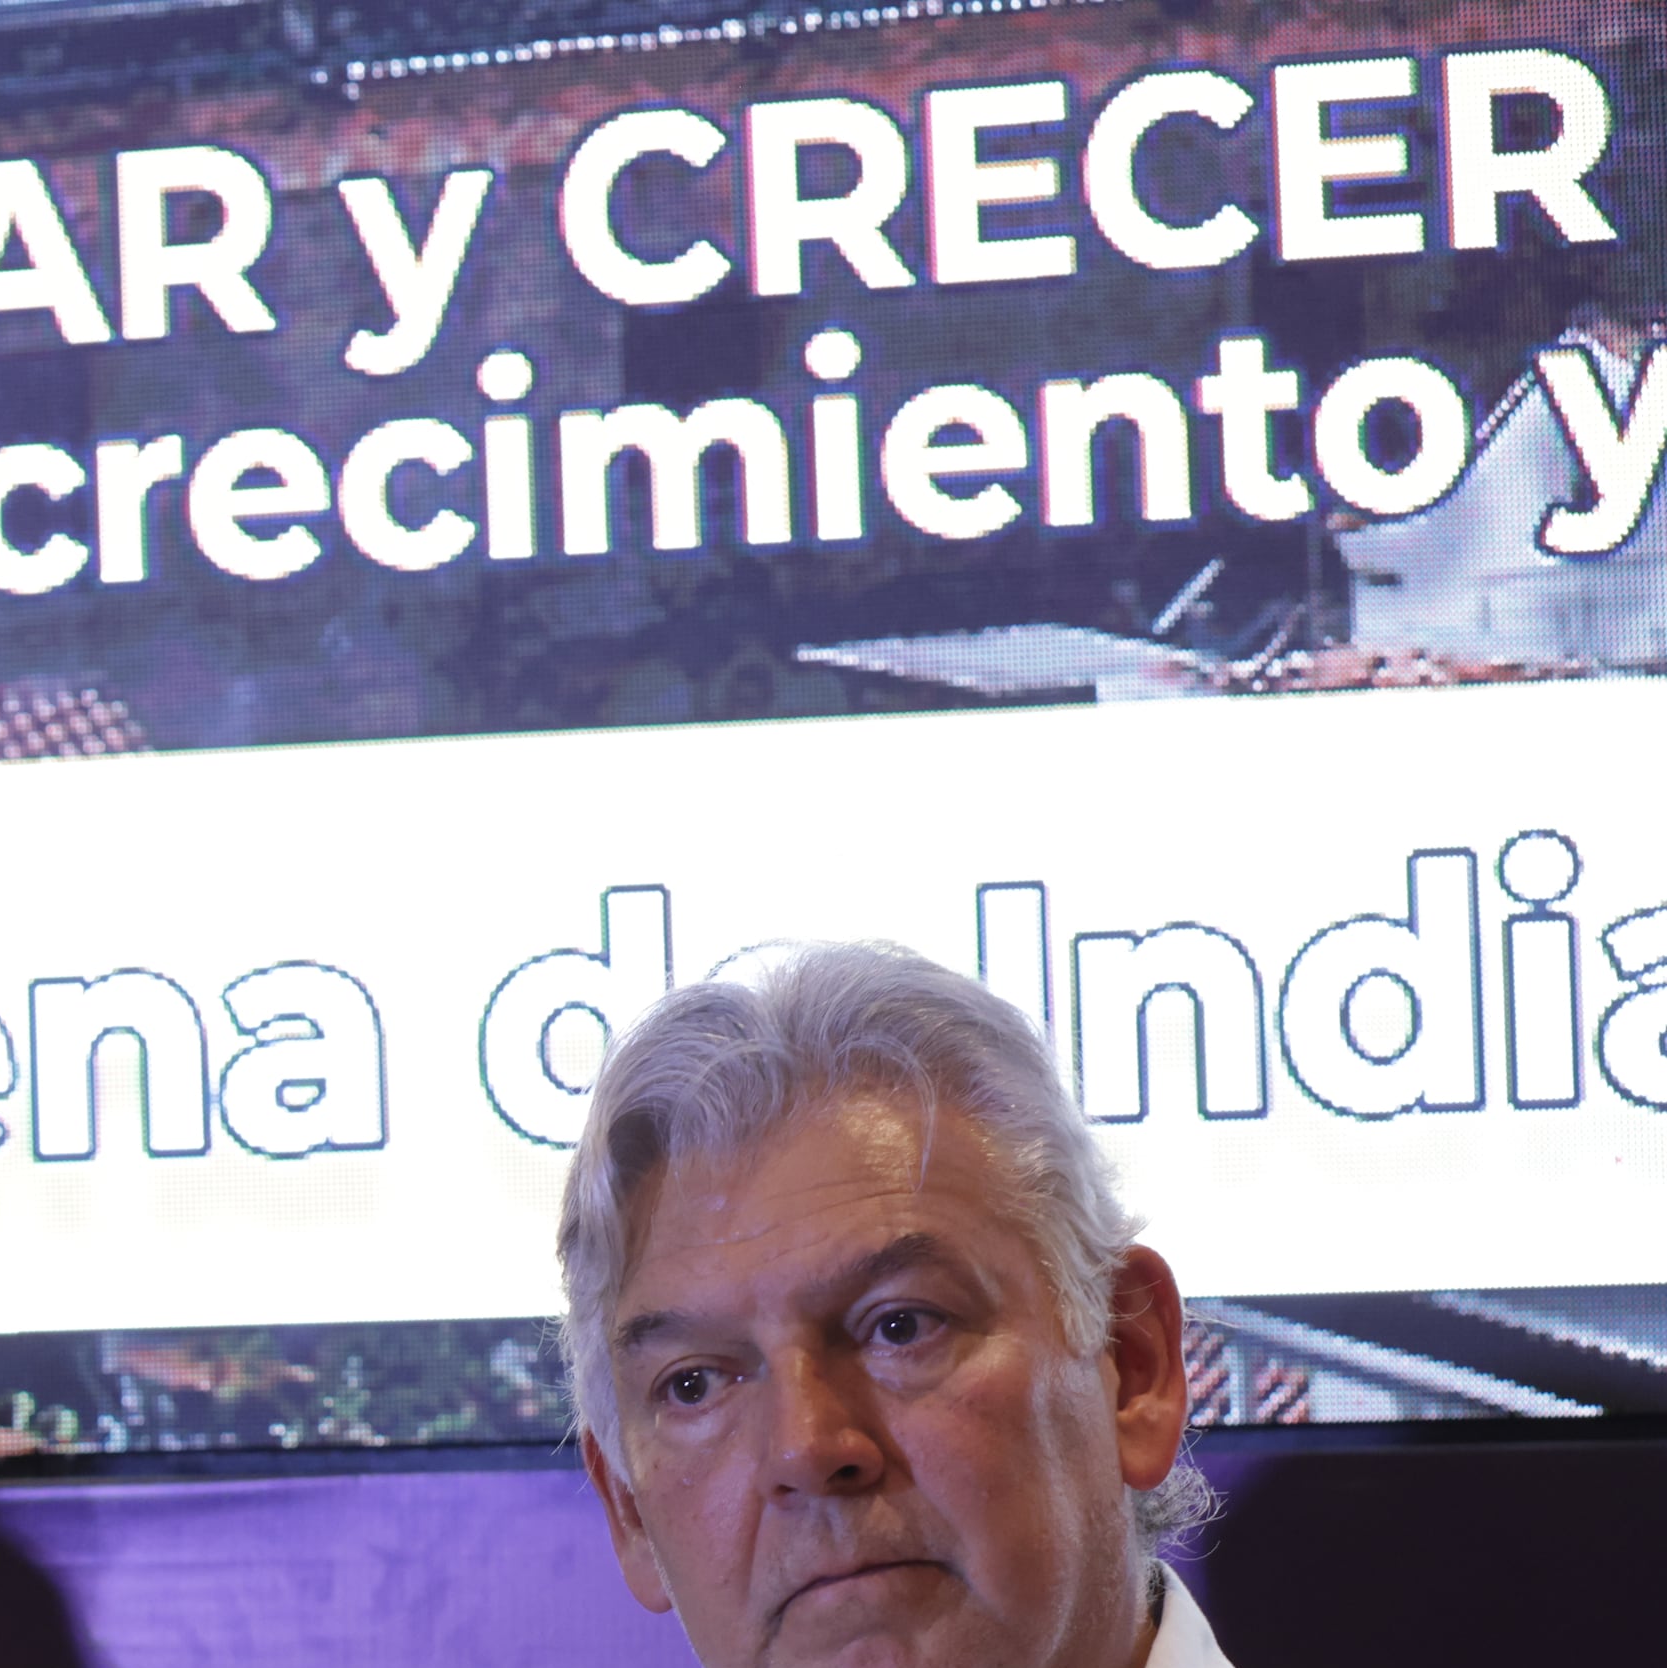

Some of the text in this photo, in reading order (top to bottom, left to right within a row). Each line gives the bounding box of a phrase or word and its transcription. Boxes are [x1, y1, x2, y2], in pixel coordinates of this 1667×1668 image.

[338, 170, 491, 376] y
[562, 47, 1619, 306] CRECER
[1537, 346, 1667, 554] y
